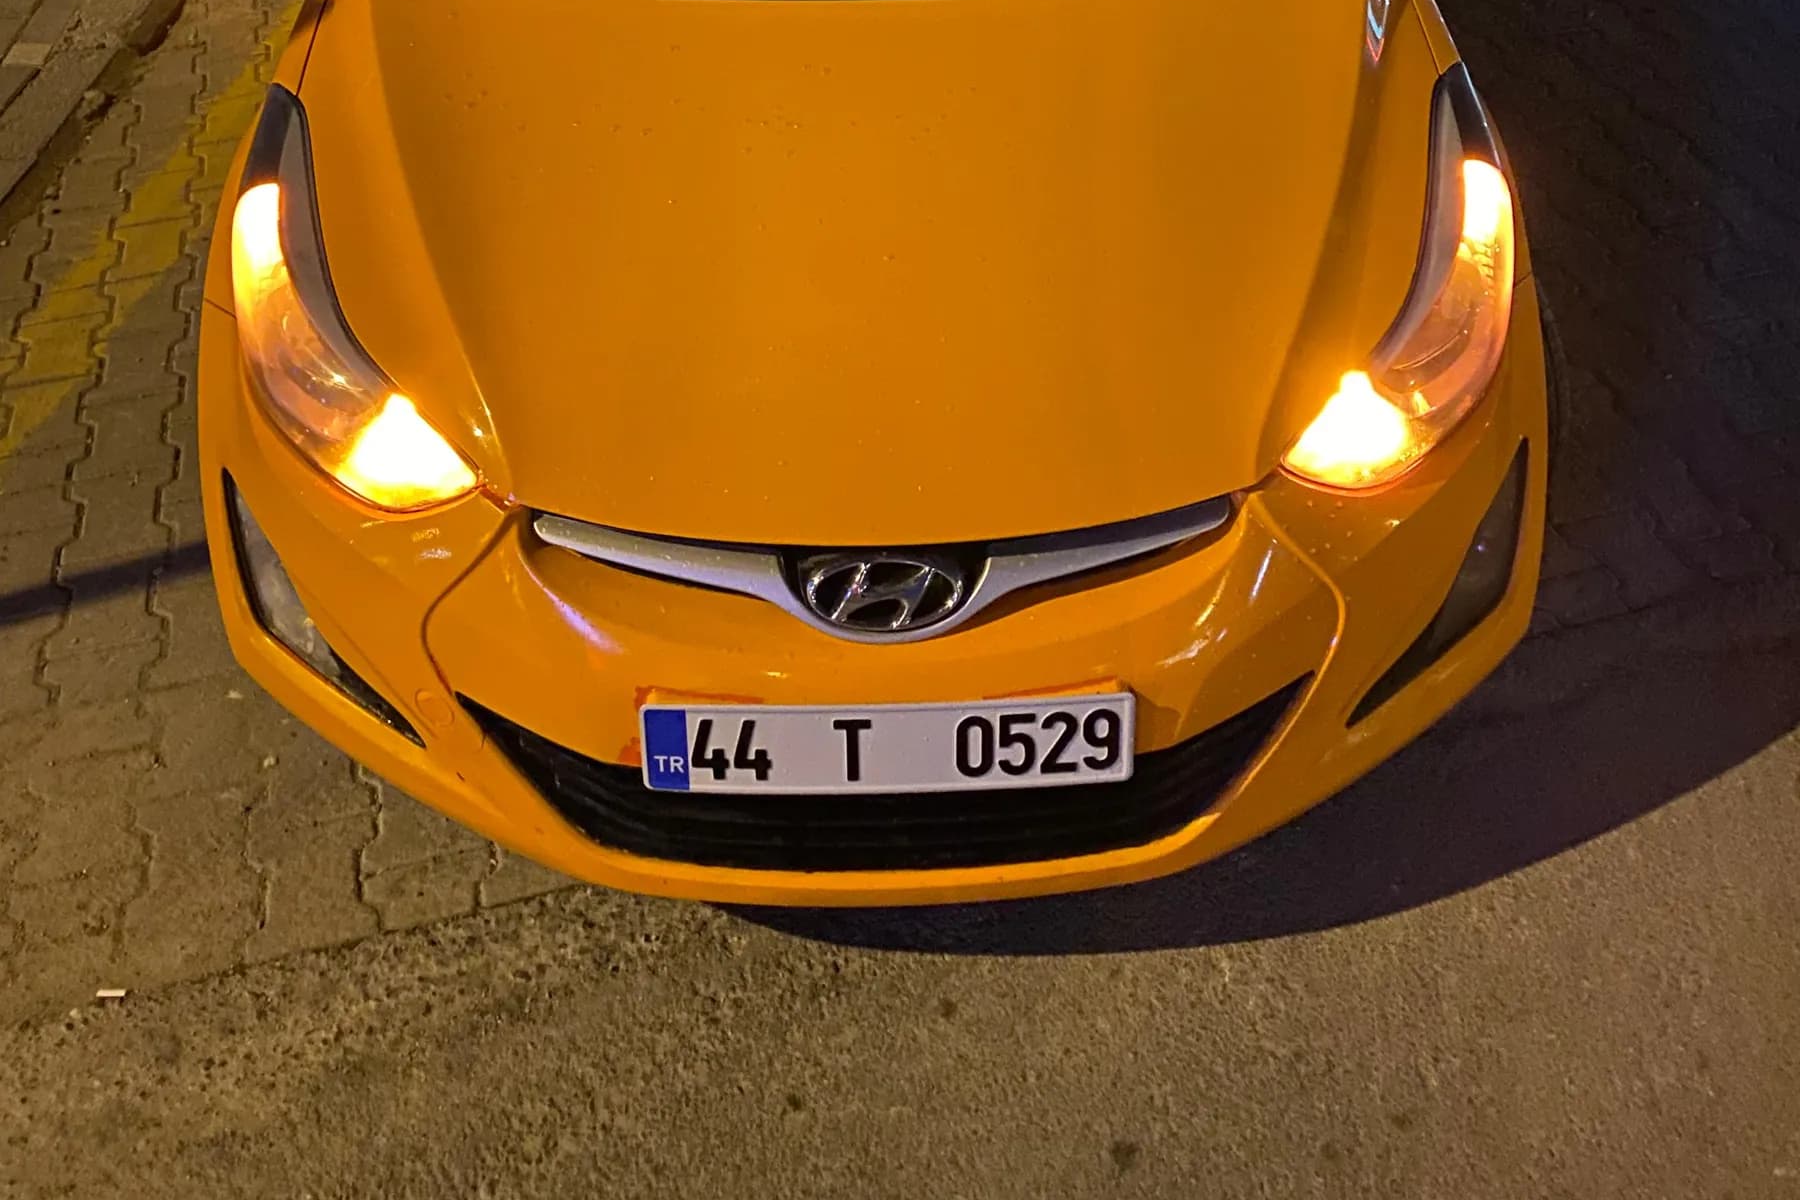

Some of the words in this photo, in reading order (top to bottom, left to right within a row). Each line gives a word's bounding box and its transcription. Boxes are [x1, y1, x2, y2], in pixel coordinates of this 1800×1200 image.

[654, 754, 685, 773] TR
[691, 718, 773, 781] 44
[832, 718, 872, 782] T
[955, 708, 1121, 778] 0529
